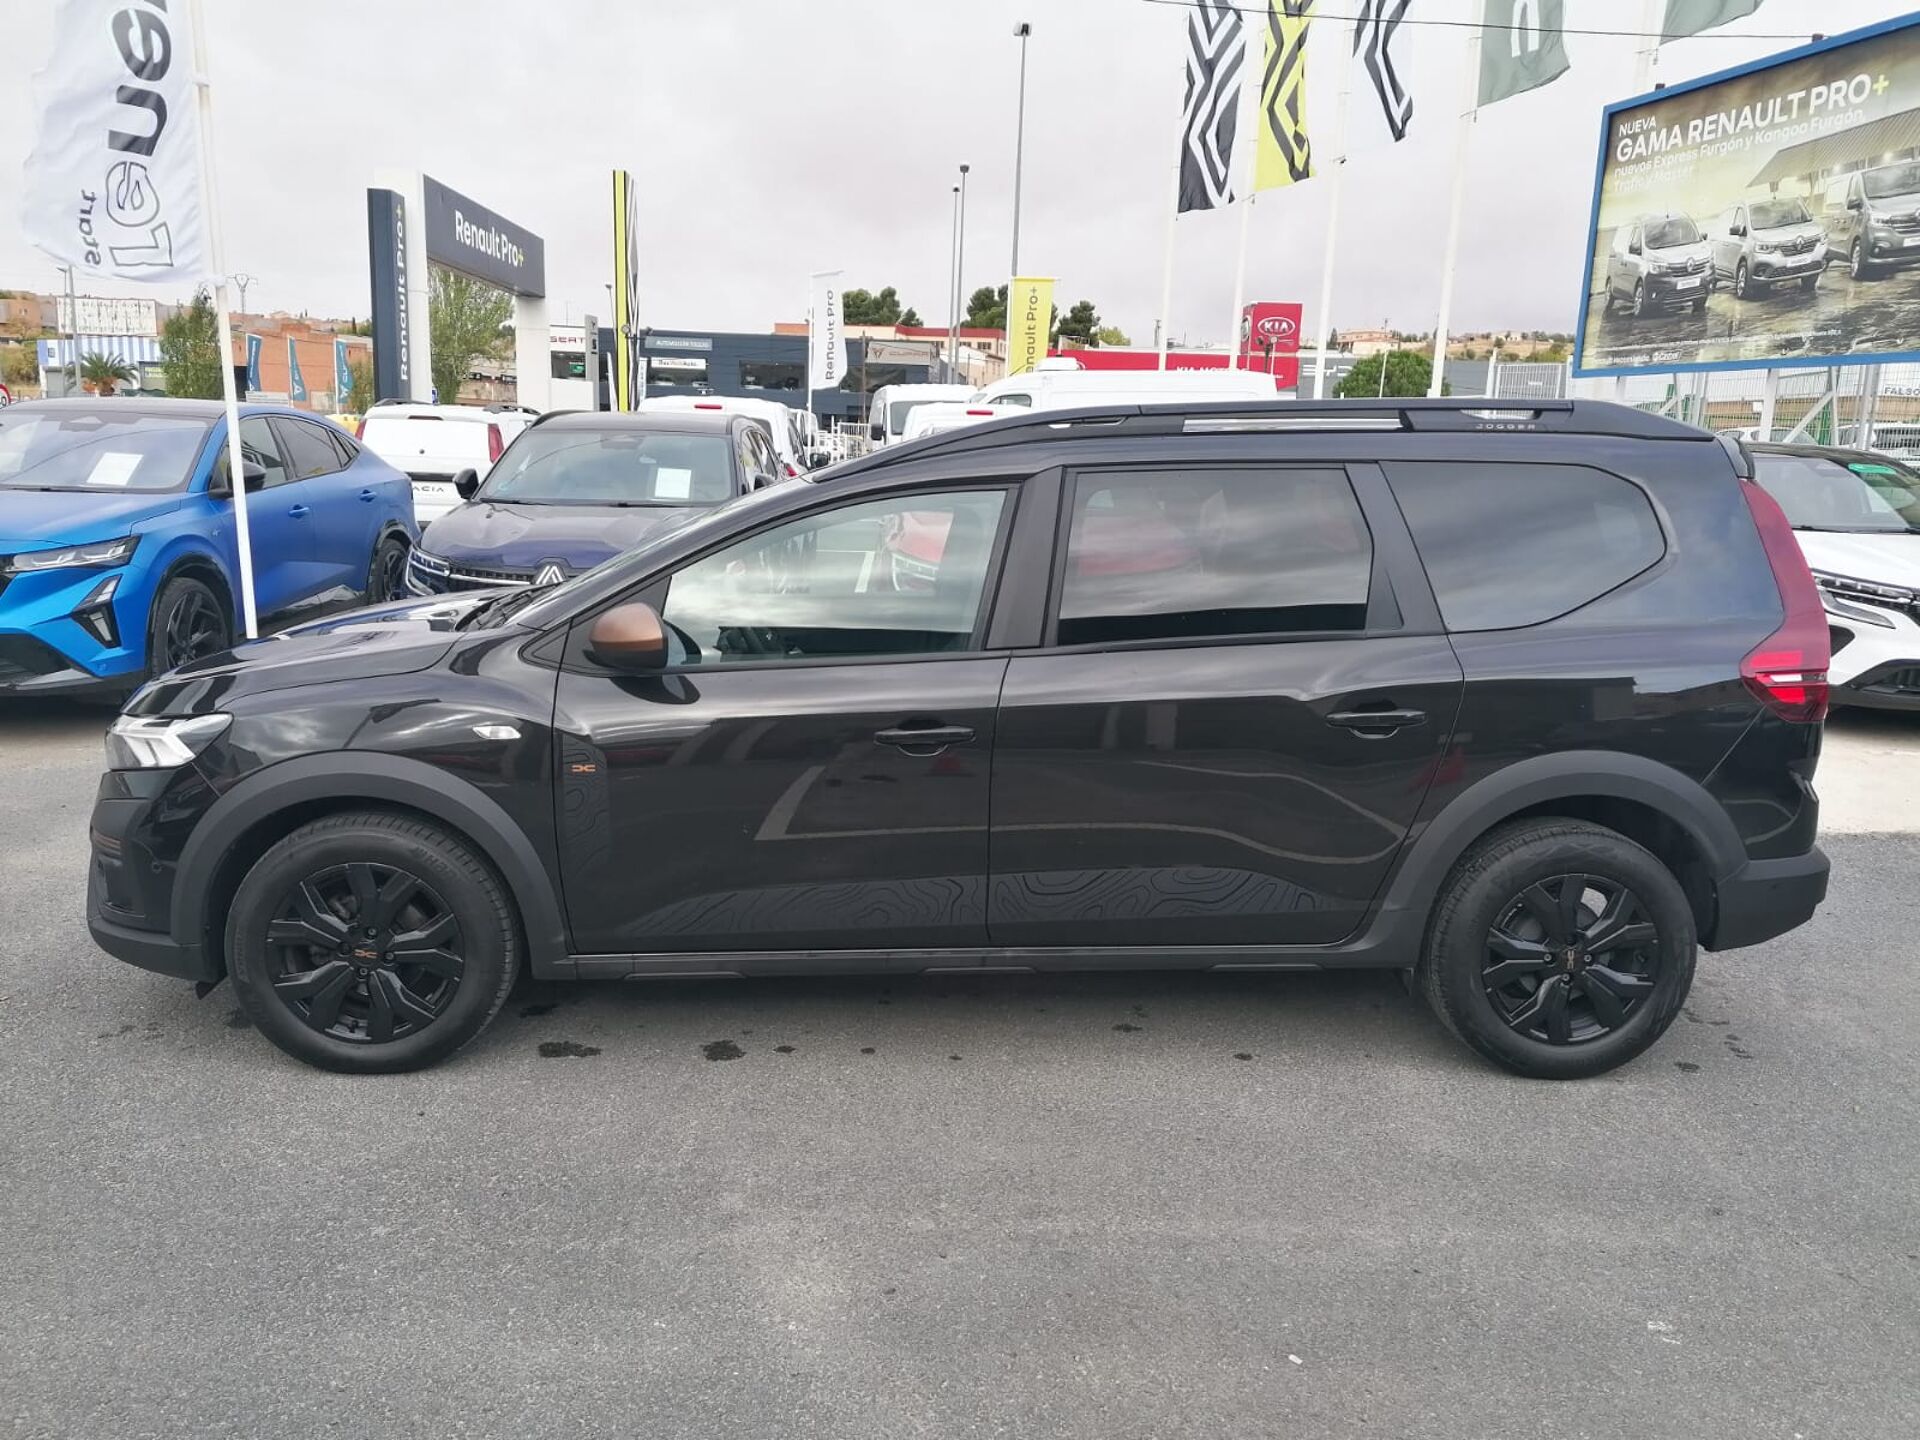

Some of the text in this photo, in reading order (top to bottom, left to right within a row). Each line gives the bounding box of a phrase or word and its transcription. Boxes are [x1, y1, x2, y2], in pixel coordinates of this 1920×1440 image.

[1614, 159, 1652, 178] nuevos
[1653, 147, 1698, 171] Express
[1700, 137, 1743, 159] Furgón
[1744, 134, 1755, 150] y
[1755, 120, 1808, 146] Kangoo
[1616, 124, 1683, 162] GAMA
[1686, 89, 1807, 146] RENAULT
[1618, 115, 1657, 137] NUEVA
[454, 209, 501, 260] Renault
[396, 272, 409, 381] Renault
[550, 335, 586, 344] SEAT
[825, 320, 836, 380] Renault
[1263, 320, 1290, 333] KIA
